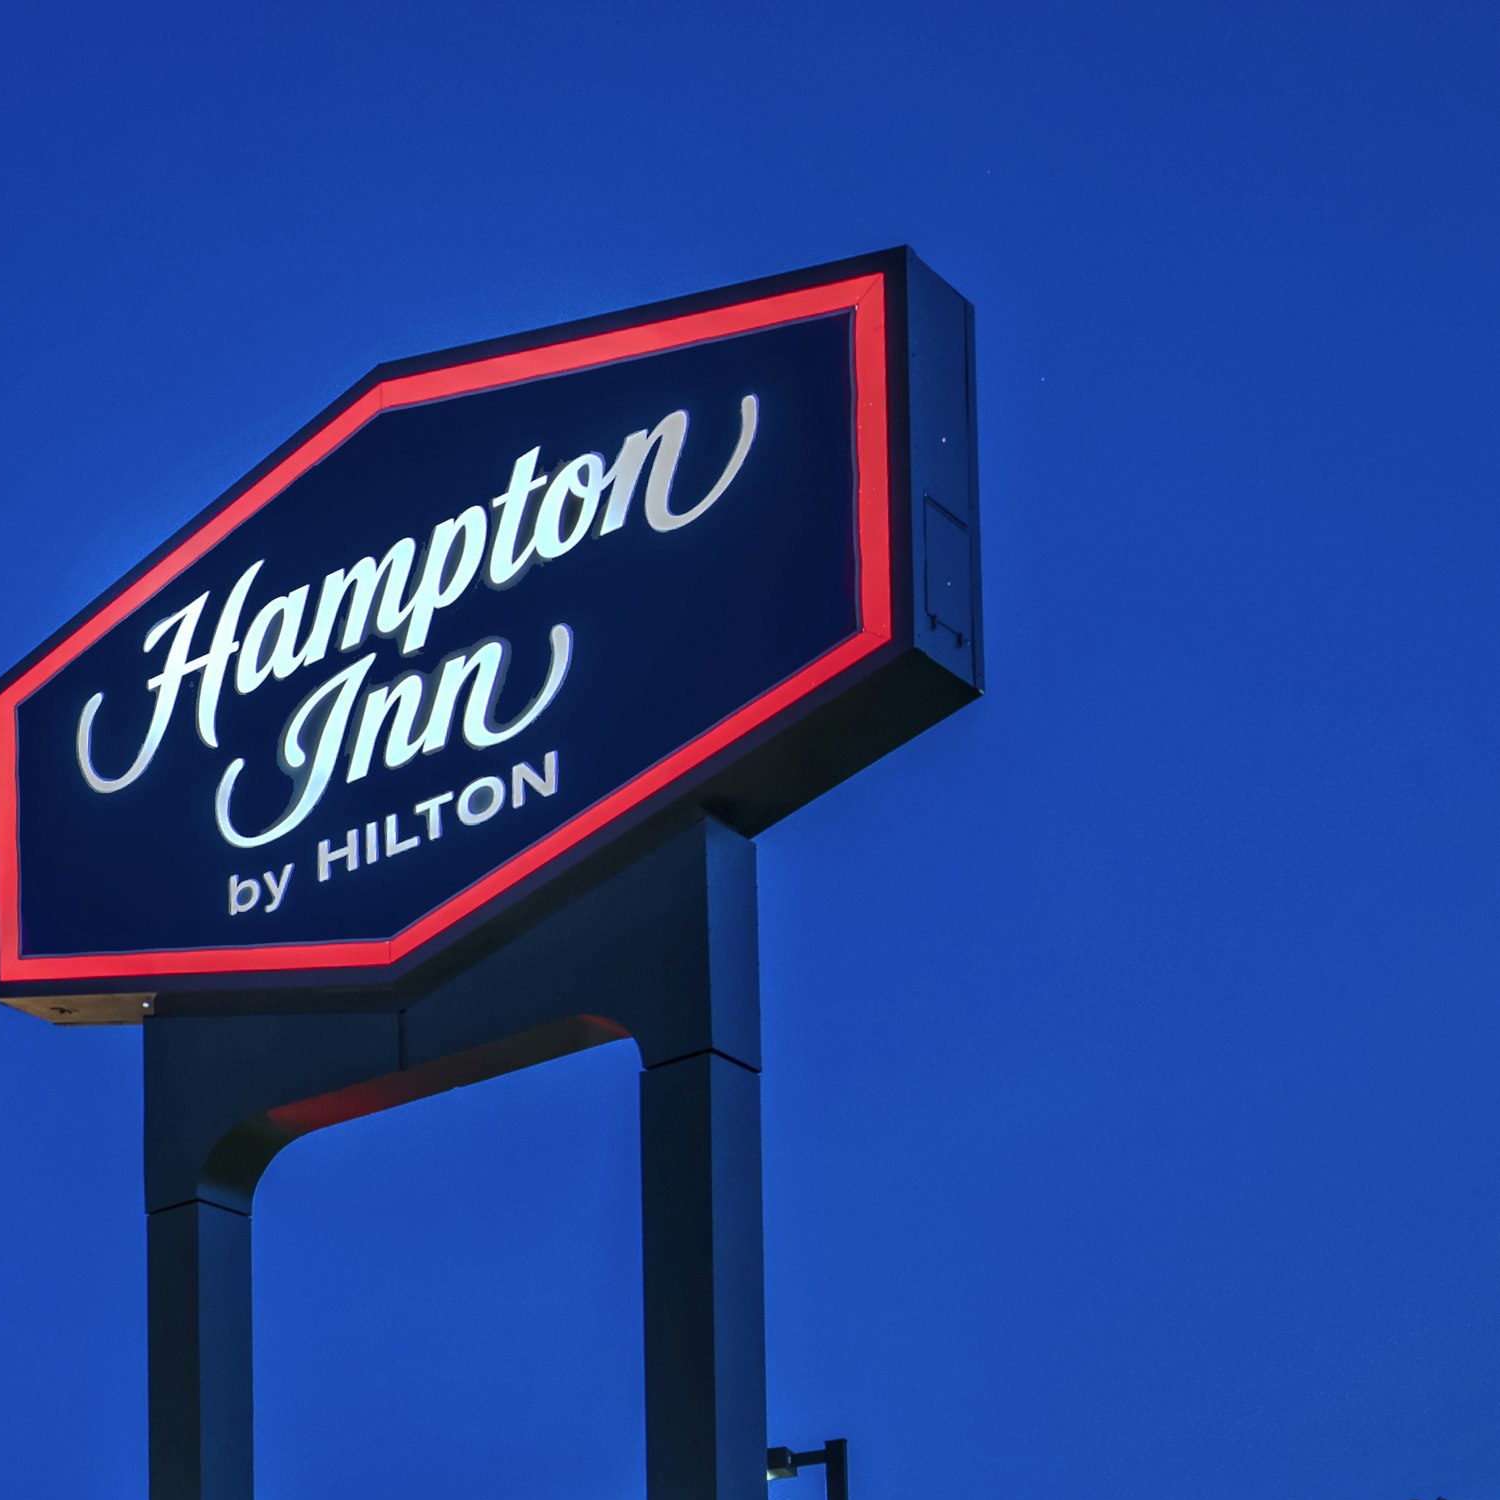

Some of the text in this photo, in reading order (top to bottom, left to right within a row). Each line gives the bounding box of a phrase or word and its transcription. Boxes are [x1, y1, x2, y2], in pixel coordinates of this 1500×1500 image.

[77, 394, 759, 794] Hampton
[214, 624, 573, 848] Inn
[228, 750, 559, 916] by HILTON
